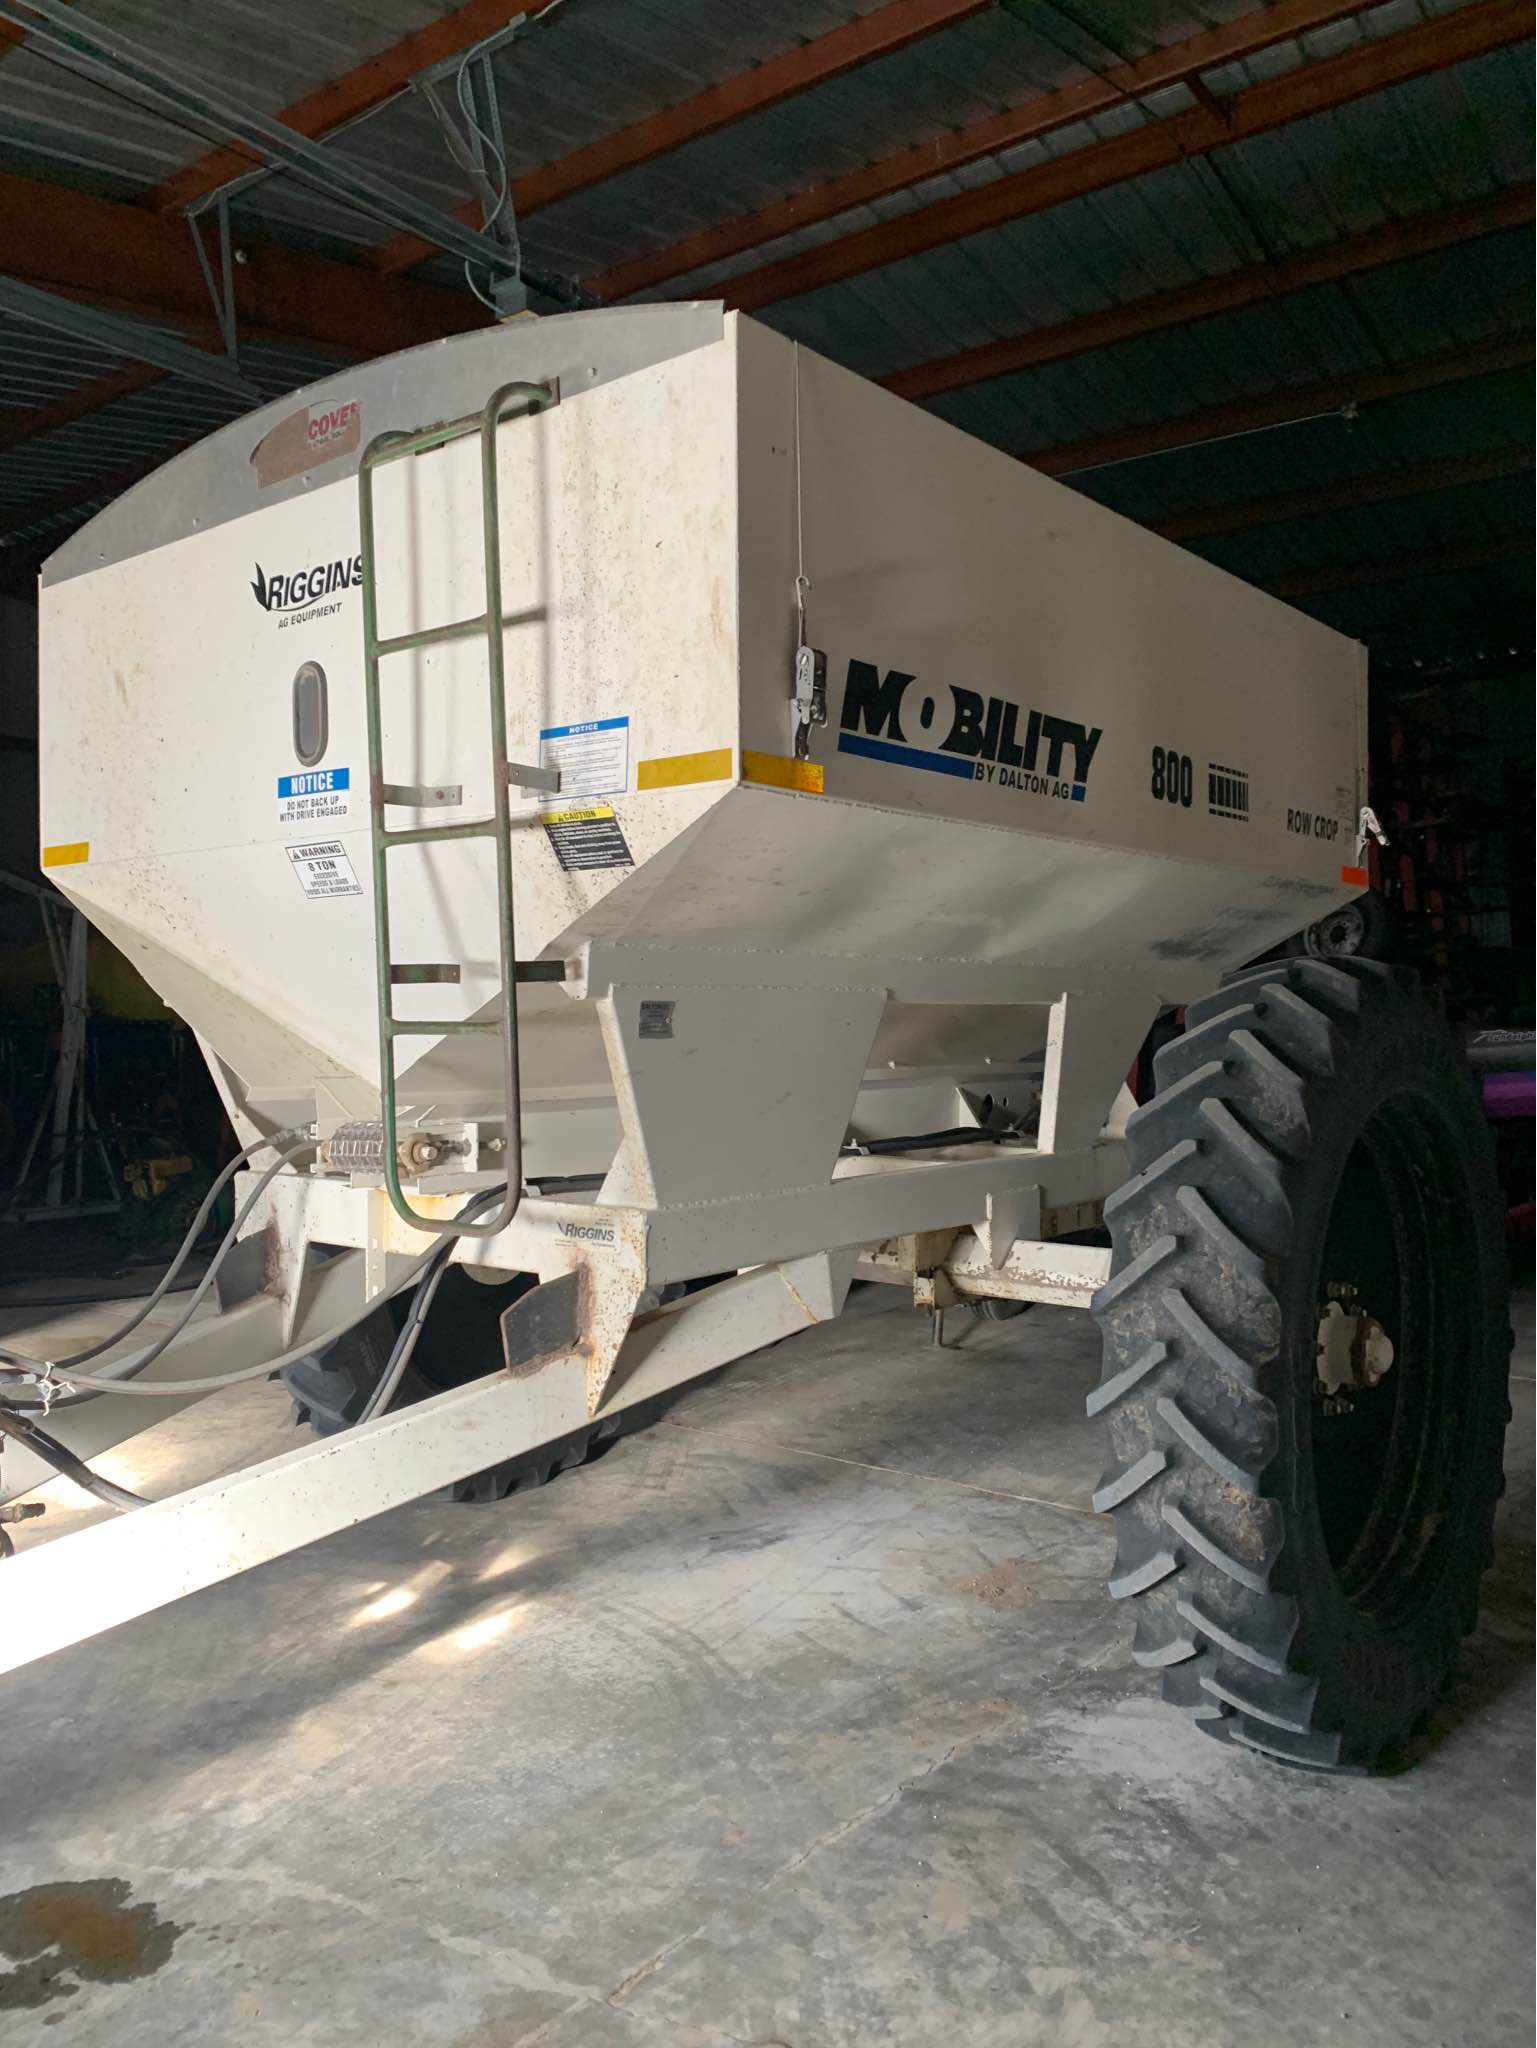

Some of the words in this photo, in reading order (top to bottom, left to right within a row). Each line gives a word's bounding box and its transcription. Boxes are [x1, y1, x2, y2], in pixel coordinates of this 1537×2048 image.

[266, 554, 363, 609] RIGGINS
[278, 615, 290, 629] AG
[291, 602, 342, 626] EQUIPMENT
[569, 723, 599, 734] NOTICE
[840, 658, 1103, 783] MOBILITY
[291, 772, 333, 794] NOTICE
[975, 762, 996, 782] BY
[999, 767, 1050, 796] DALTON
[1052, 780, 1070, 800] AG
[1151, 745, 1193, 808] 800
[287, 801, 296, 811] DO
[297, 799, 309, 809] NOT
[311, 797, 328, 808] BACK
[330, 796, 339, 805] UP
[280, 812, 295, 822] WITH
[296, 810, 315, 820] DRIVE
[317, 806, 347, 818] ENGAGED
[563, 811, 596, 821] CAUTION
[1287, 808, 1312, 836] ROW
[1314, 815, 1339, 842] CROP
[299, 844, 341, 858] WARNING
[308, 862, 315, 872] 8
[316, 860, 336, 871] TON
[565, 1223, 615, 1241] RIGGINS
